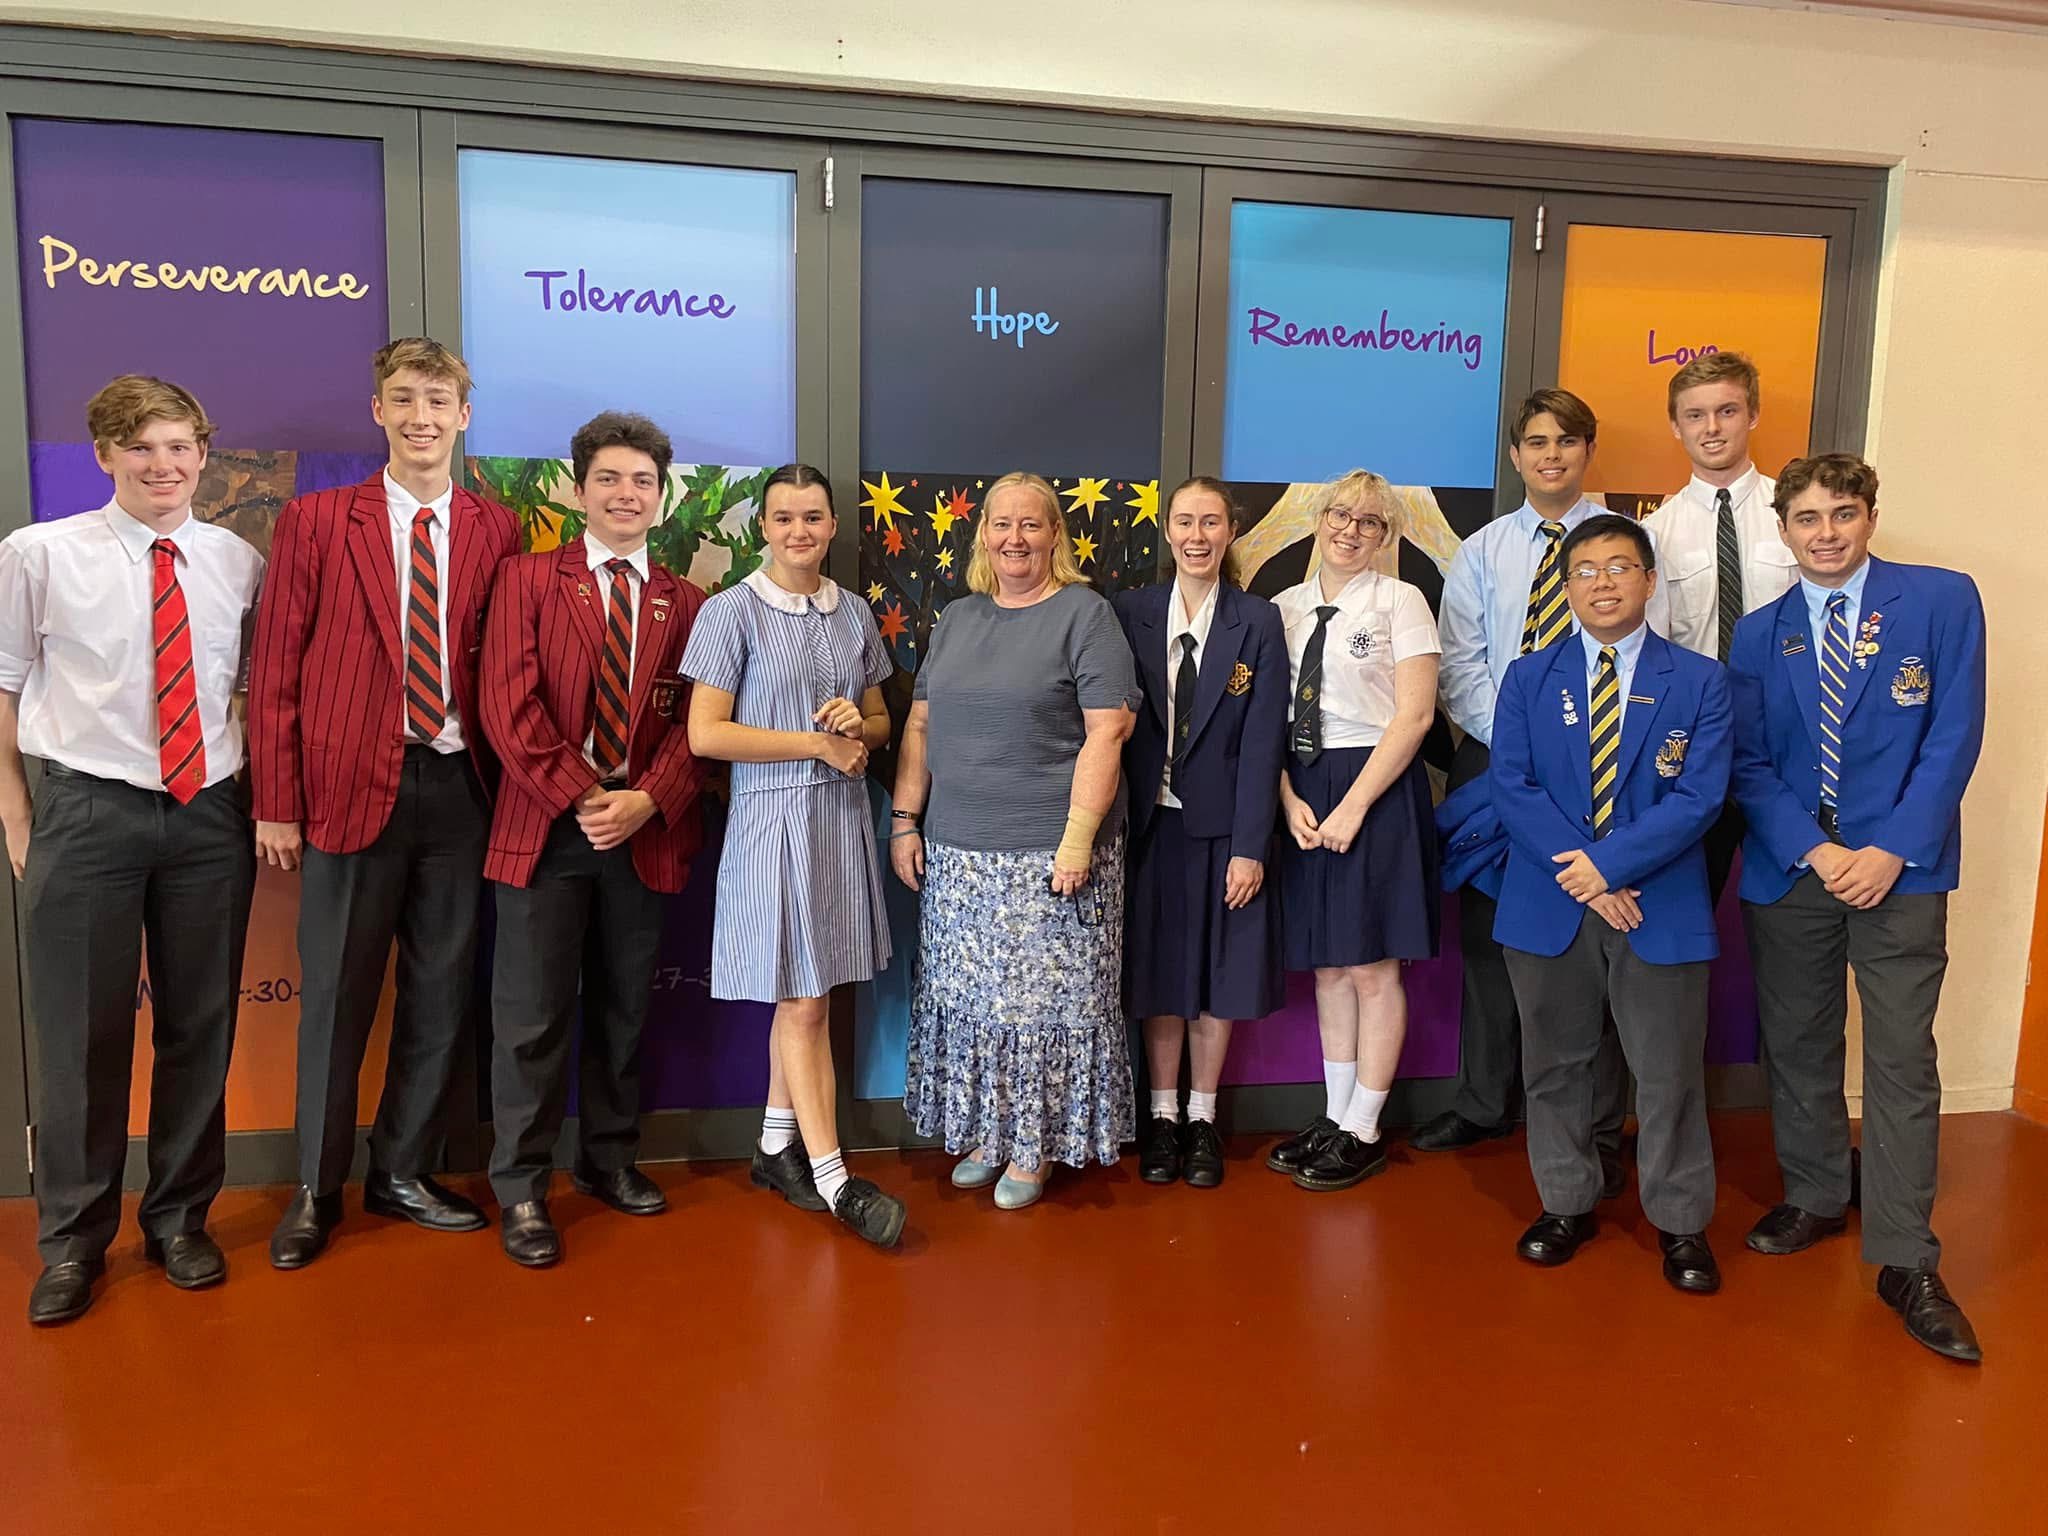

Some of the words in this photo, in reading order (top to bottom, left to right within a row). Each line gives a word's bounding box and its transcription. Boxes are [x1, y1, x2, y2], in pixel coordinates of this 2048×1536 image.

[38, 234, 370, 300] Perseverance
[524, 268, 736, 319] Tolerance
[970, 286, 1060, 349] Hope
[1247, 306, 1483, 371] Remembering
